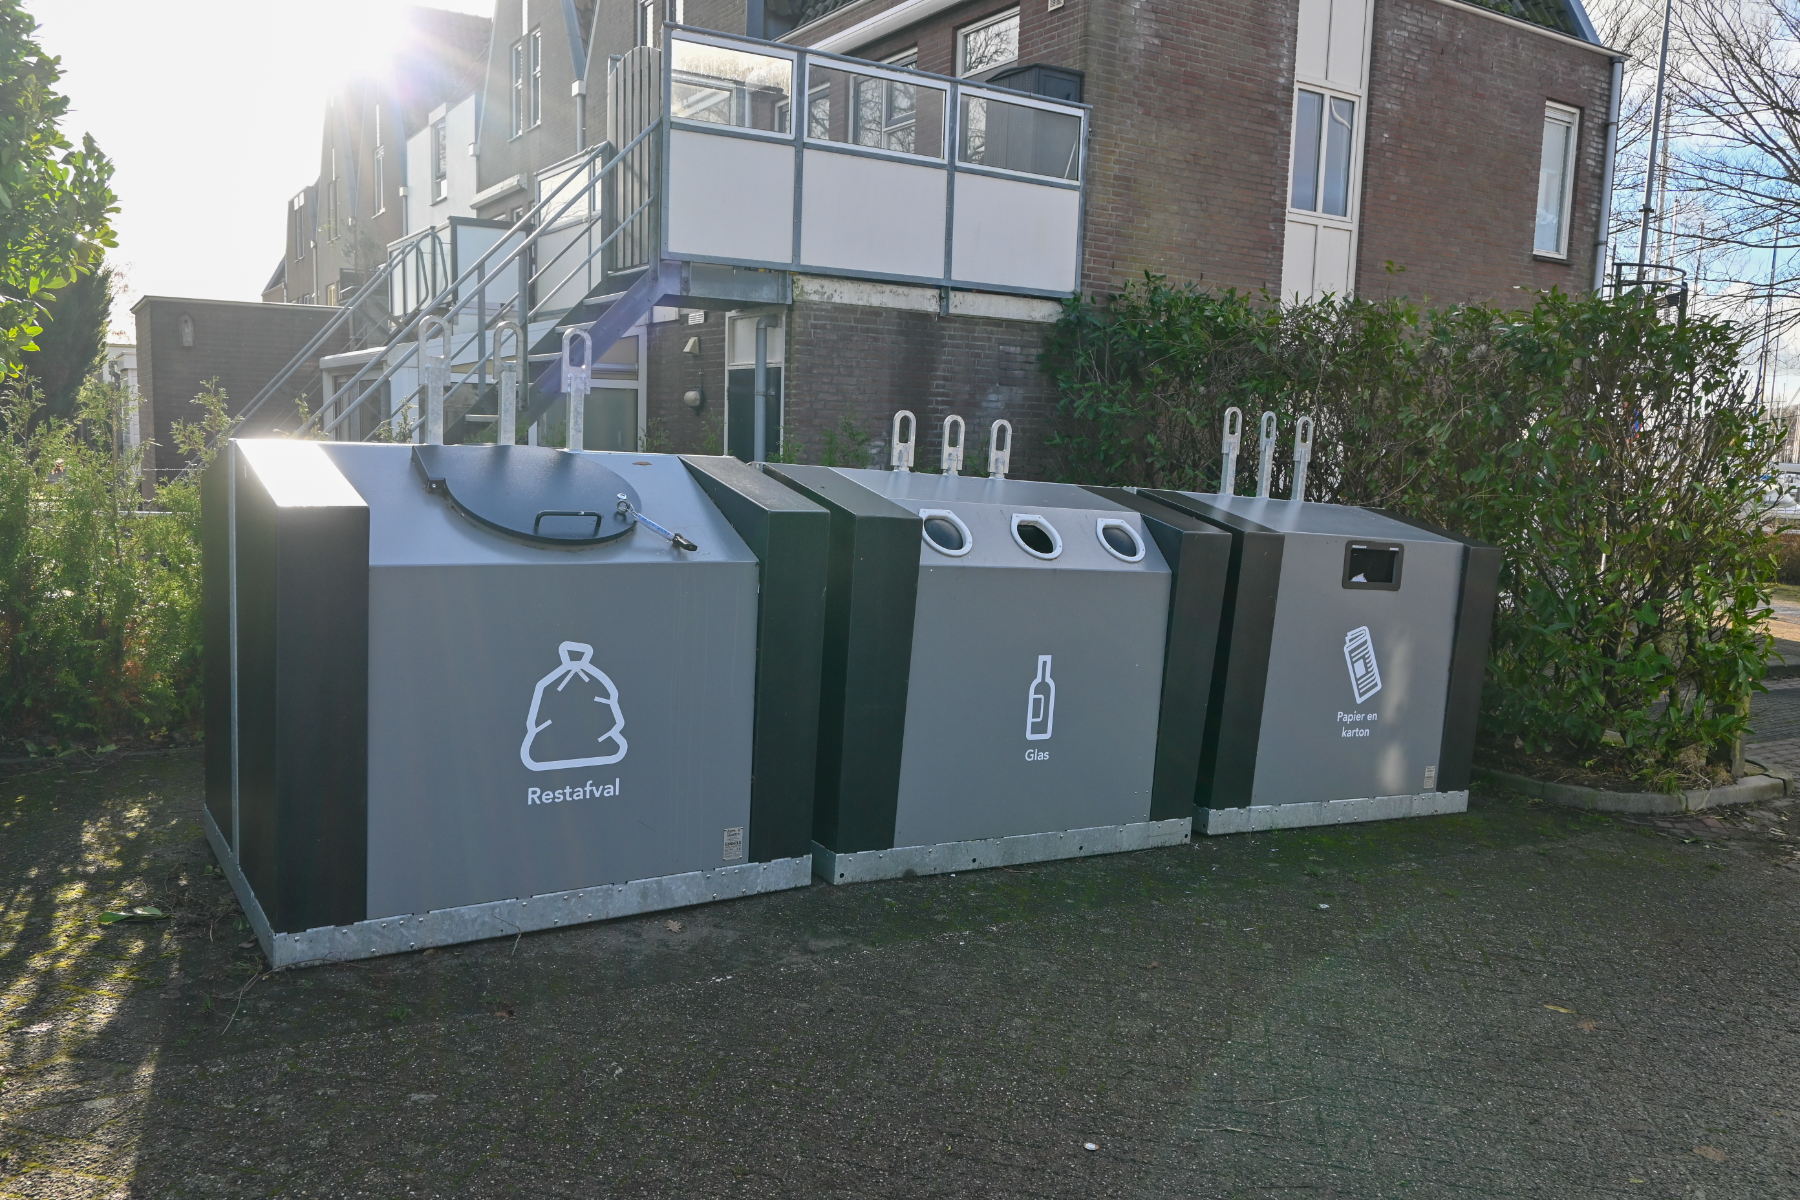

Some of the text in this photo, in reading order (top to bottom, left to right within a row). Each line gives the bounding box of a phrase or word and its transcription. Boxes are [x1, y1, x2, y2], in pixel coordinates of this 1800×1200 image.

[1337, 711, 1378, 724] Papier en
[1341, 727, 1370, 738] karton
[1025, 749, 1050, 761] Glas
[527, 778, 620, 805] Restafval
